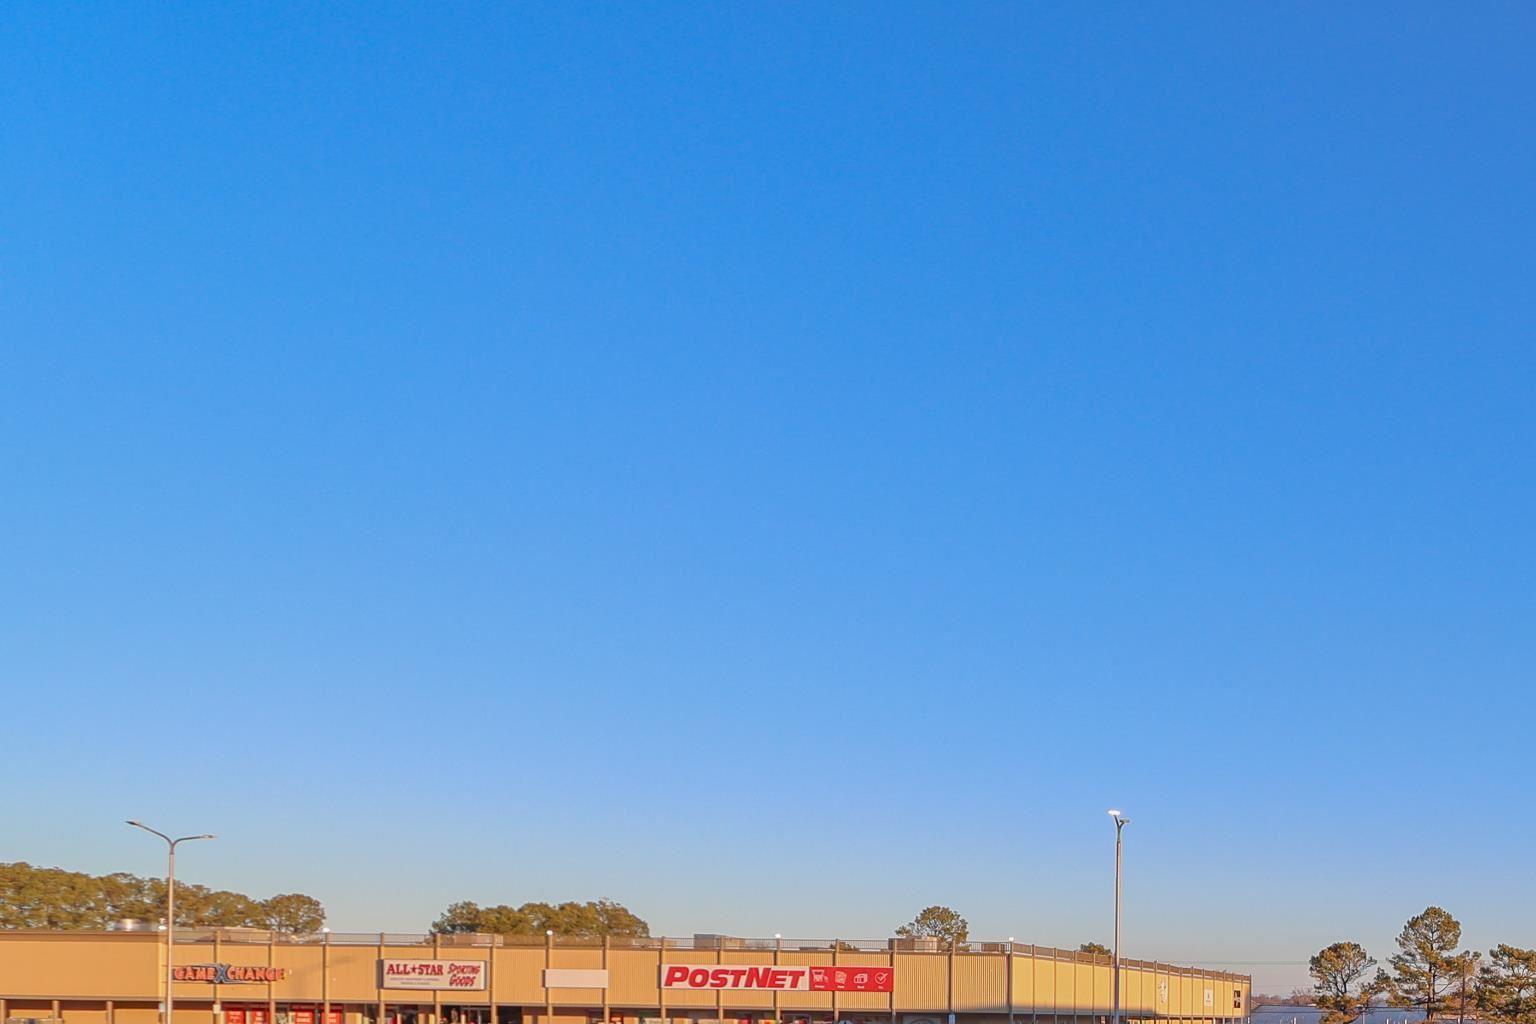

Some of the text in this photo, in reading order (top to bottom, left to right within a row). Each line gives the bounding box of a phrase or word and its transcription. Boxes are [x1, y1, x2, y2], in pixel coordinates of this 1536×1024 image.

[386, 964, 443, 976] ALL STAR
[449, 974, 476, 987] GOODS
[664, 966, 805, 989] POSTNET
